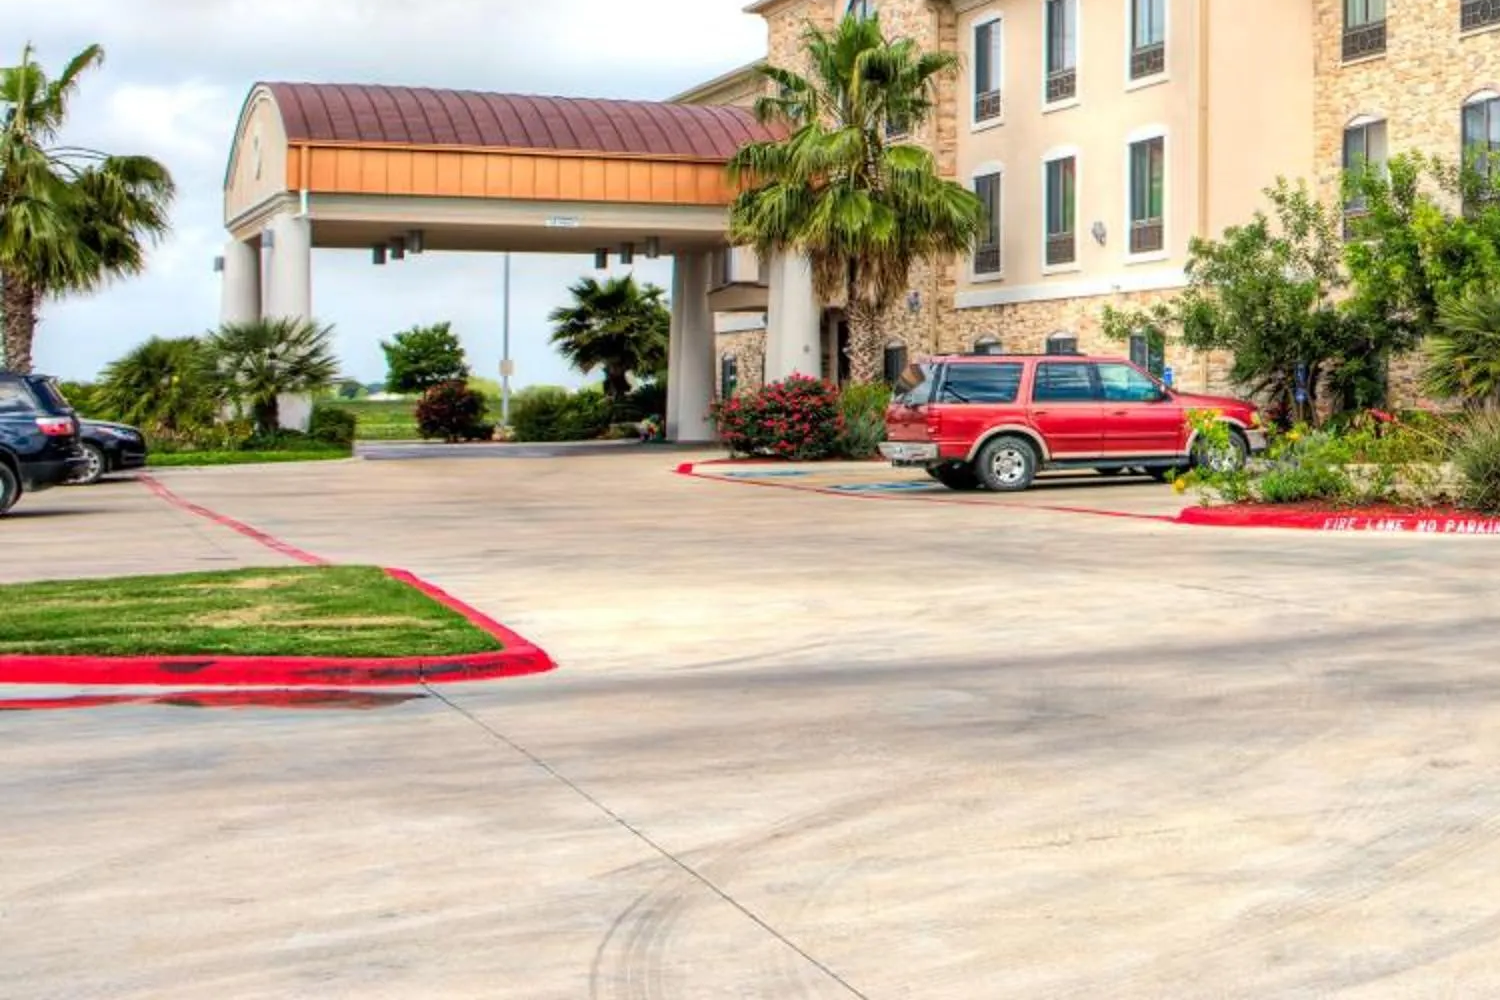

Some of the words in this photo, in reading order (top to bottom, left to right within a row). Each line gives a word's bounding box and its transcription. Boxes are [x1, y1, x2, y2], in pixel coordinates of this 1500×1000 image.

[1323, 516, 1358, 532] FIRE
[1364, 518, 1405, 533] LANE
[1414, 518, 1438, 534] NO
